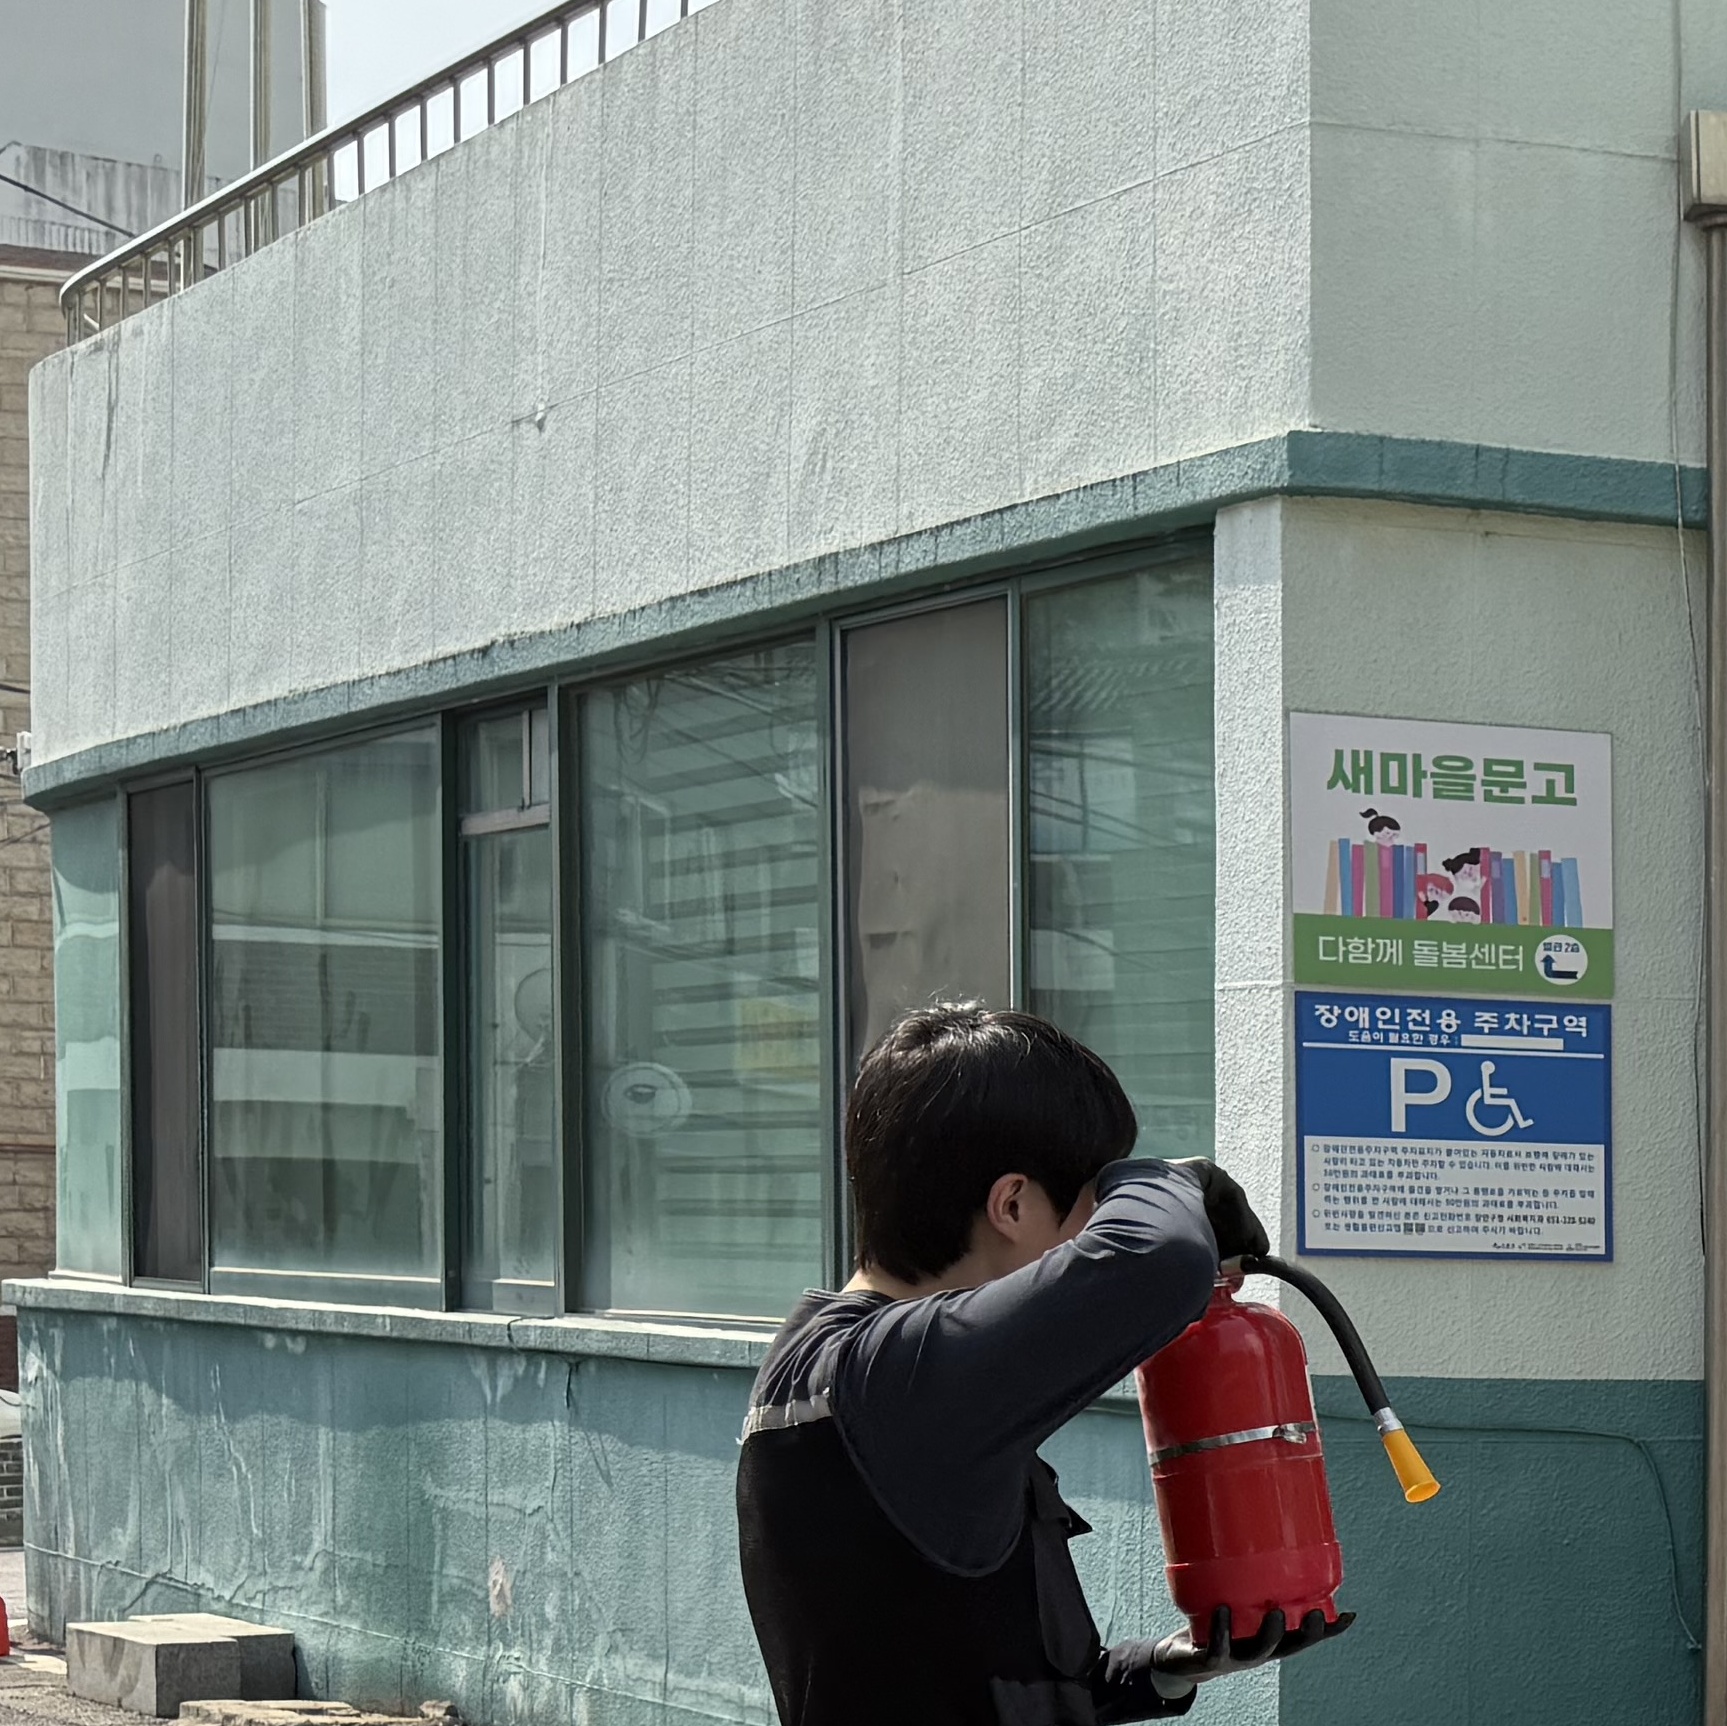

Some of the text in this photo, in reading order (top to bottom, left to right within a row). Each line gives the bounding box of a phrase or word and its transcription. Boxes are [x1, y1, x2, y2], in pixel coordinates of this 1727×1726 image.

[1326, 748, 1578, 805] 새마을문고
[1318, 936, 1524, 971] 다함께 돌봄센터
[1314, 1004, 1587, 1037] 장애인전용 주차구역
[1348, 1031, 1384, 1043] 도움이
[1429, 1033, 1451, 1046] 경우
[1391, 1057, 1452, 1133] P
